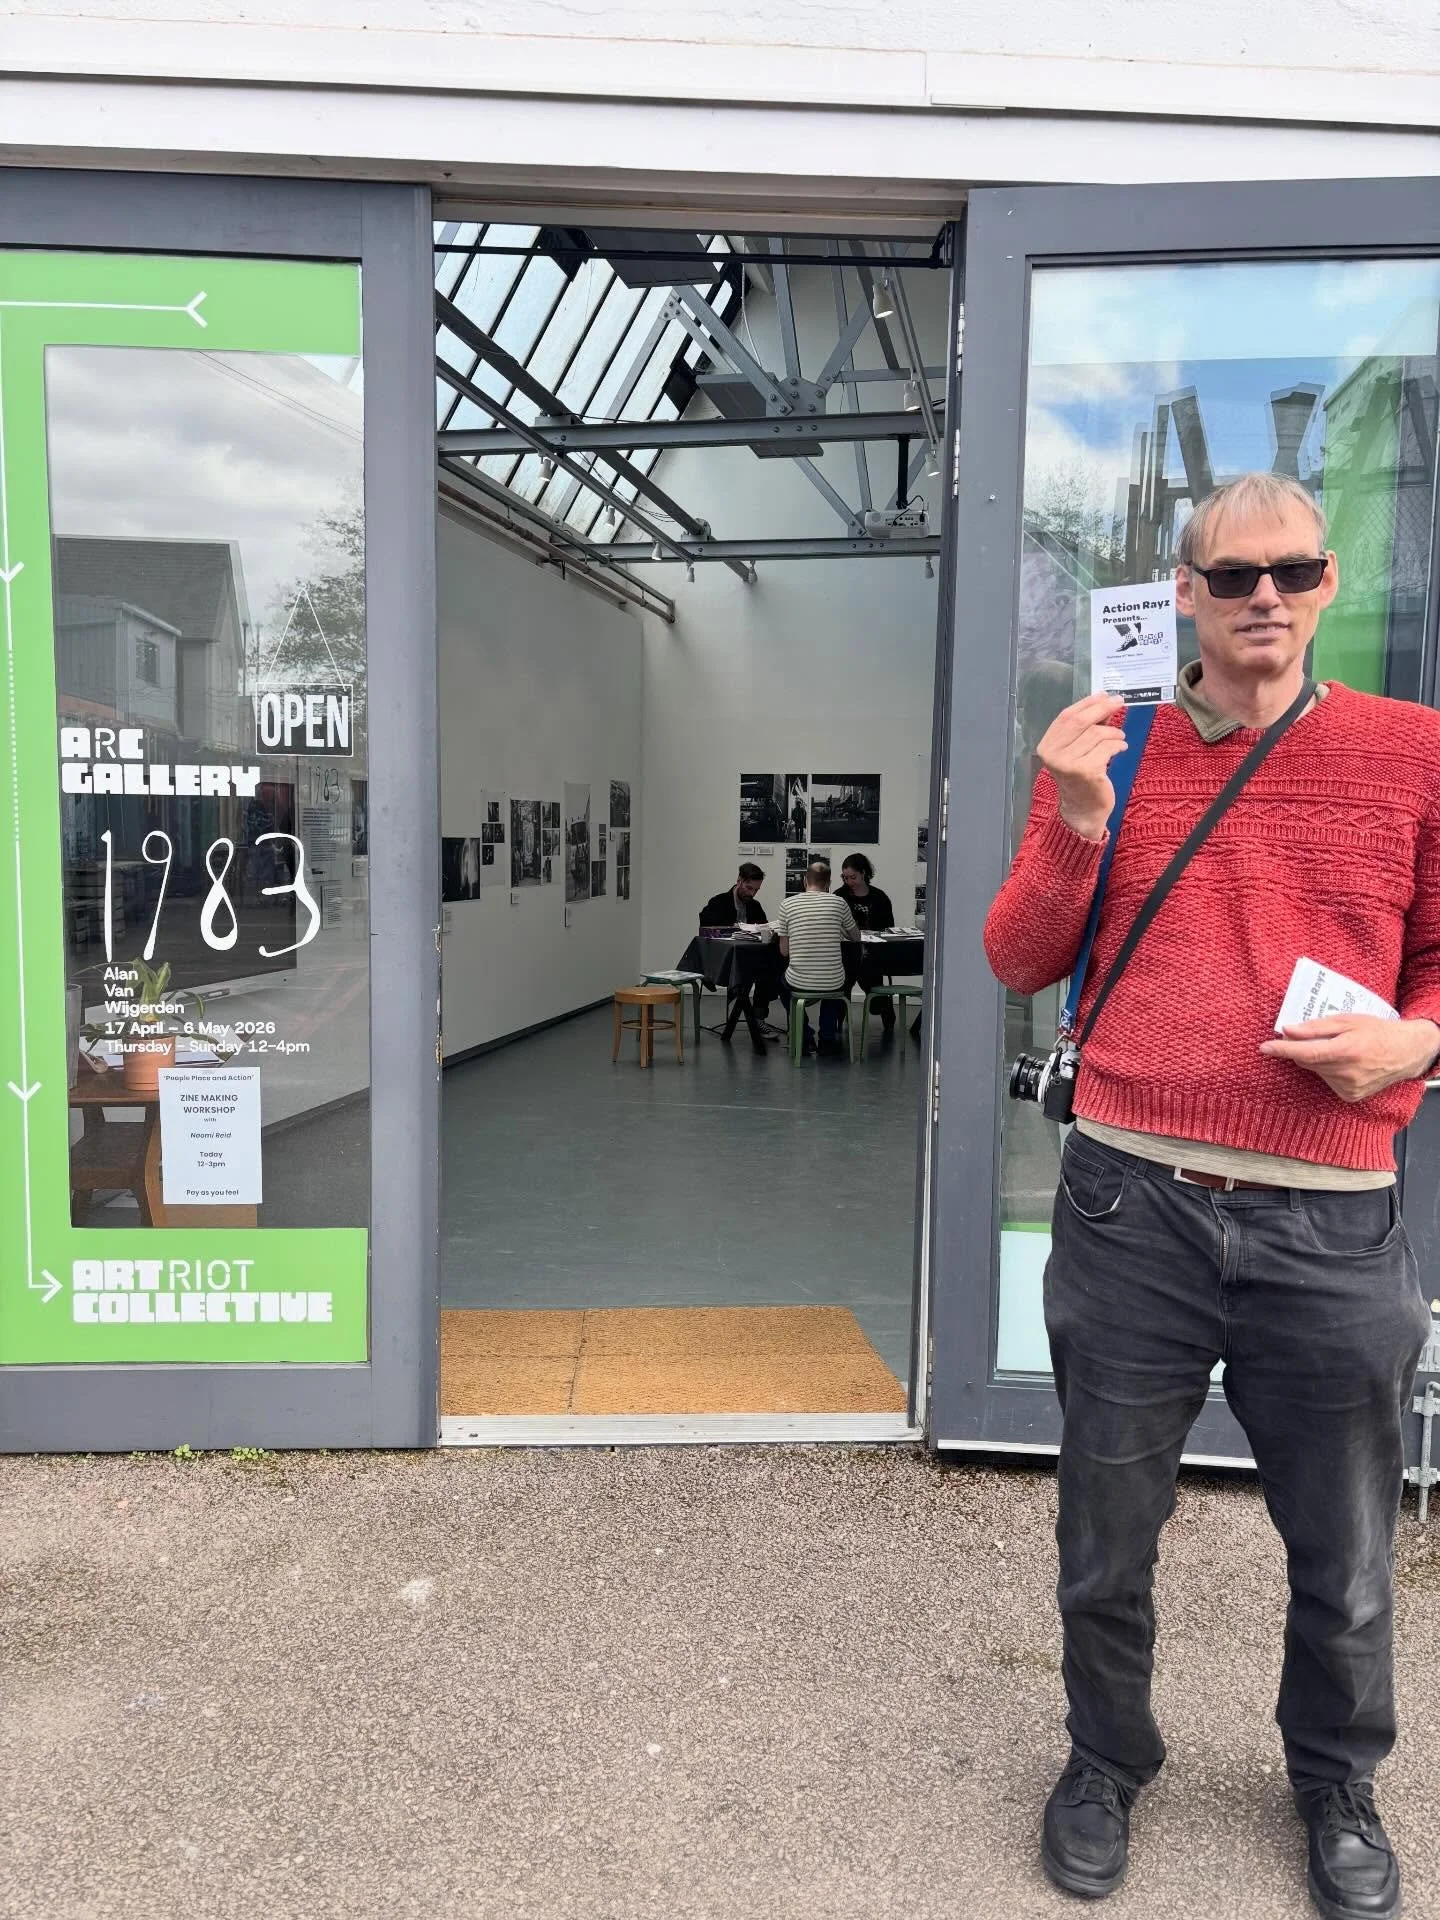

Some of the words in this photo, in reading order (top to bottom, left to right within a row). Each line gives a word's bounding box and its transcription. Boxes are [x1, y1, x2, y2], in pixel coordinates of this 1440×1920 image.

[1103, 602, 1140, 614] Action
[1143, 600, 1170, 610] Rayz
[260, 693, 349, 748] OPEN
[61, 727, 143, 759] ARC
[61, 763, 260, 797] GALLERY
[101, 830, 321, 962] 1983
[104, 967, 138, 981] Alan
[104, 984, 134, 997] Van
[1311, 971, 1326, 996] Rayz
[105, 1001, 184, 1017] Wijgerden
[105, 1022, 125, 1034] 17
[130, 1022, 163, 1037] April
[183, 1022, 194, 1034] 6
[199, 1022, 230, 1037] May
[235, 1022, 275, 1034] 2026
[107, 1040, 171, 1055] Thursday
[190, 1040, 243, 1055] Sunday
[186, 1189, 199, 1197] Pay
[73, 1292, 332, 1323] COLLECTIVE
